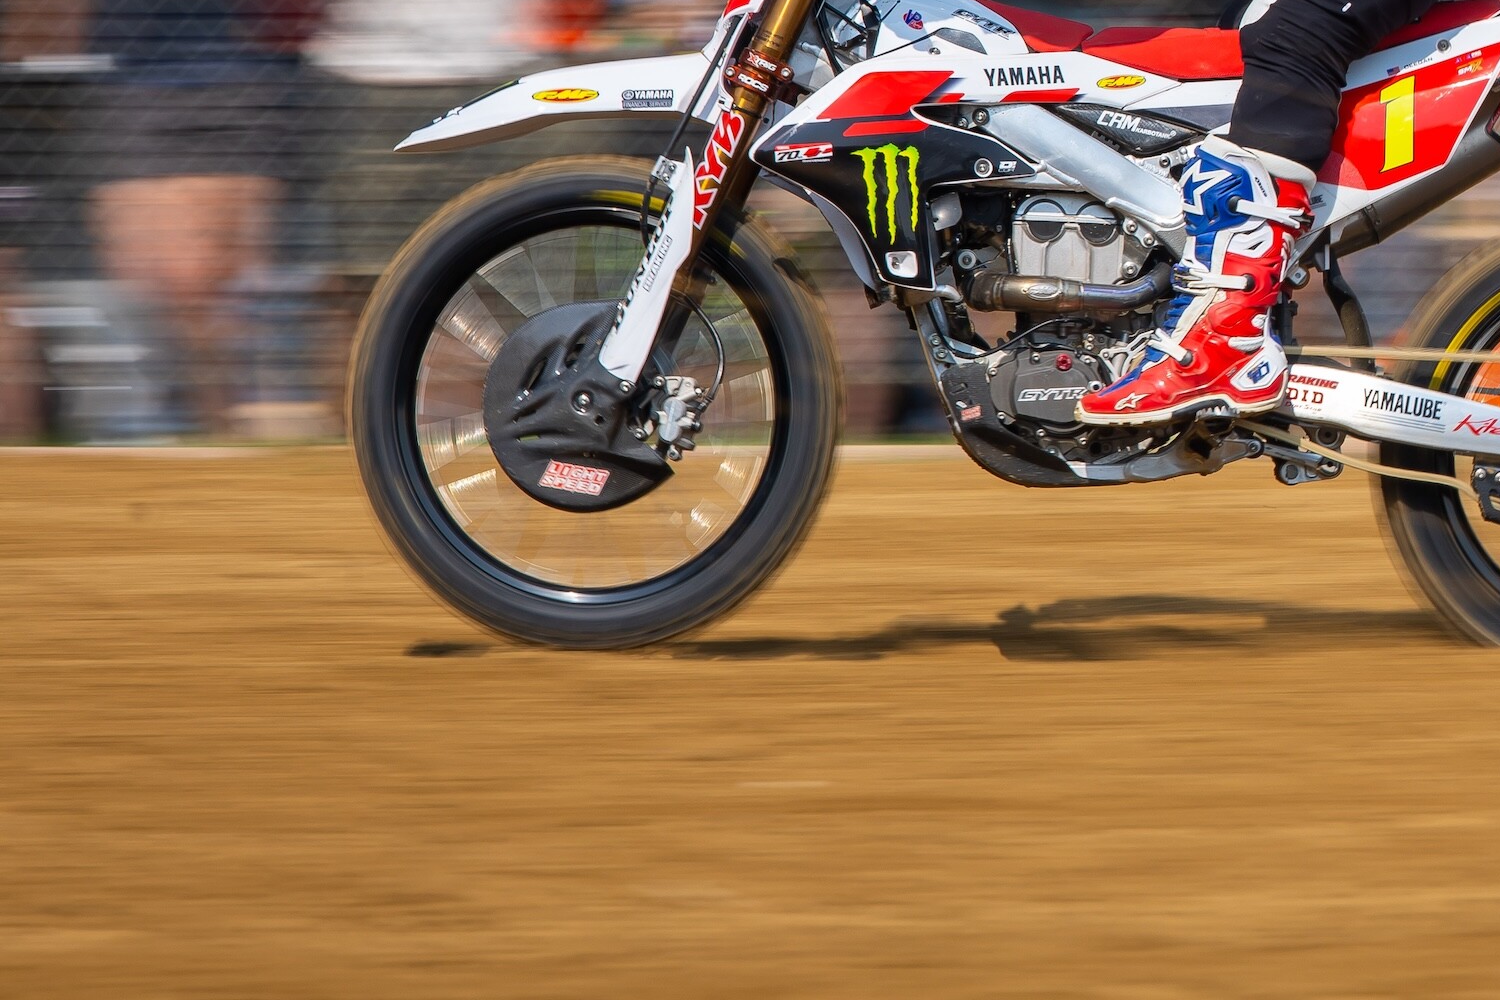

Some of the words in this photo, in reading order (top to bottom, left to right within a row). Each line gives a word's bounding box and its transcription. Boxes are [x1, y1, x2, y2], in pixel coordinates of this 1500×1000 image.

[738, 73, 769, 92] ROCS
[984, 65, 1065, 87] YAMAHA
[1097, 76, 1146, 89] FMF
[532, 89, 599, 101] FMF
[623, 100, 648, 108] FINANCIAL
[649, 100, 672, 108] SERVICES
[634, 89, 674, 100] YAMAHA
[1097, 110, 1141, 132] CRM
[1379, 75, 1415, 173] 1
[692, 110, 745, 230] KYB
[1289, 374, 1339, 389] RAKING
[1017, 387, 1088, 402] GYTR
[1363, 388, 1443, 420] YAMALUBE
[547, 462, 609, 482] LIGHT
[540, 474, 601, 493] SPEED
